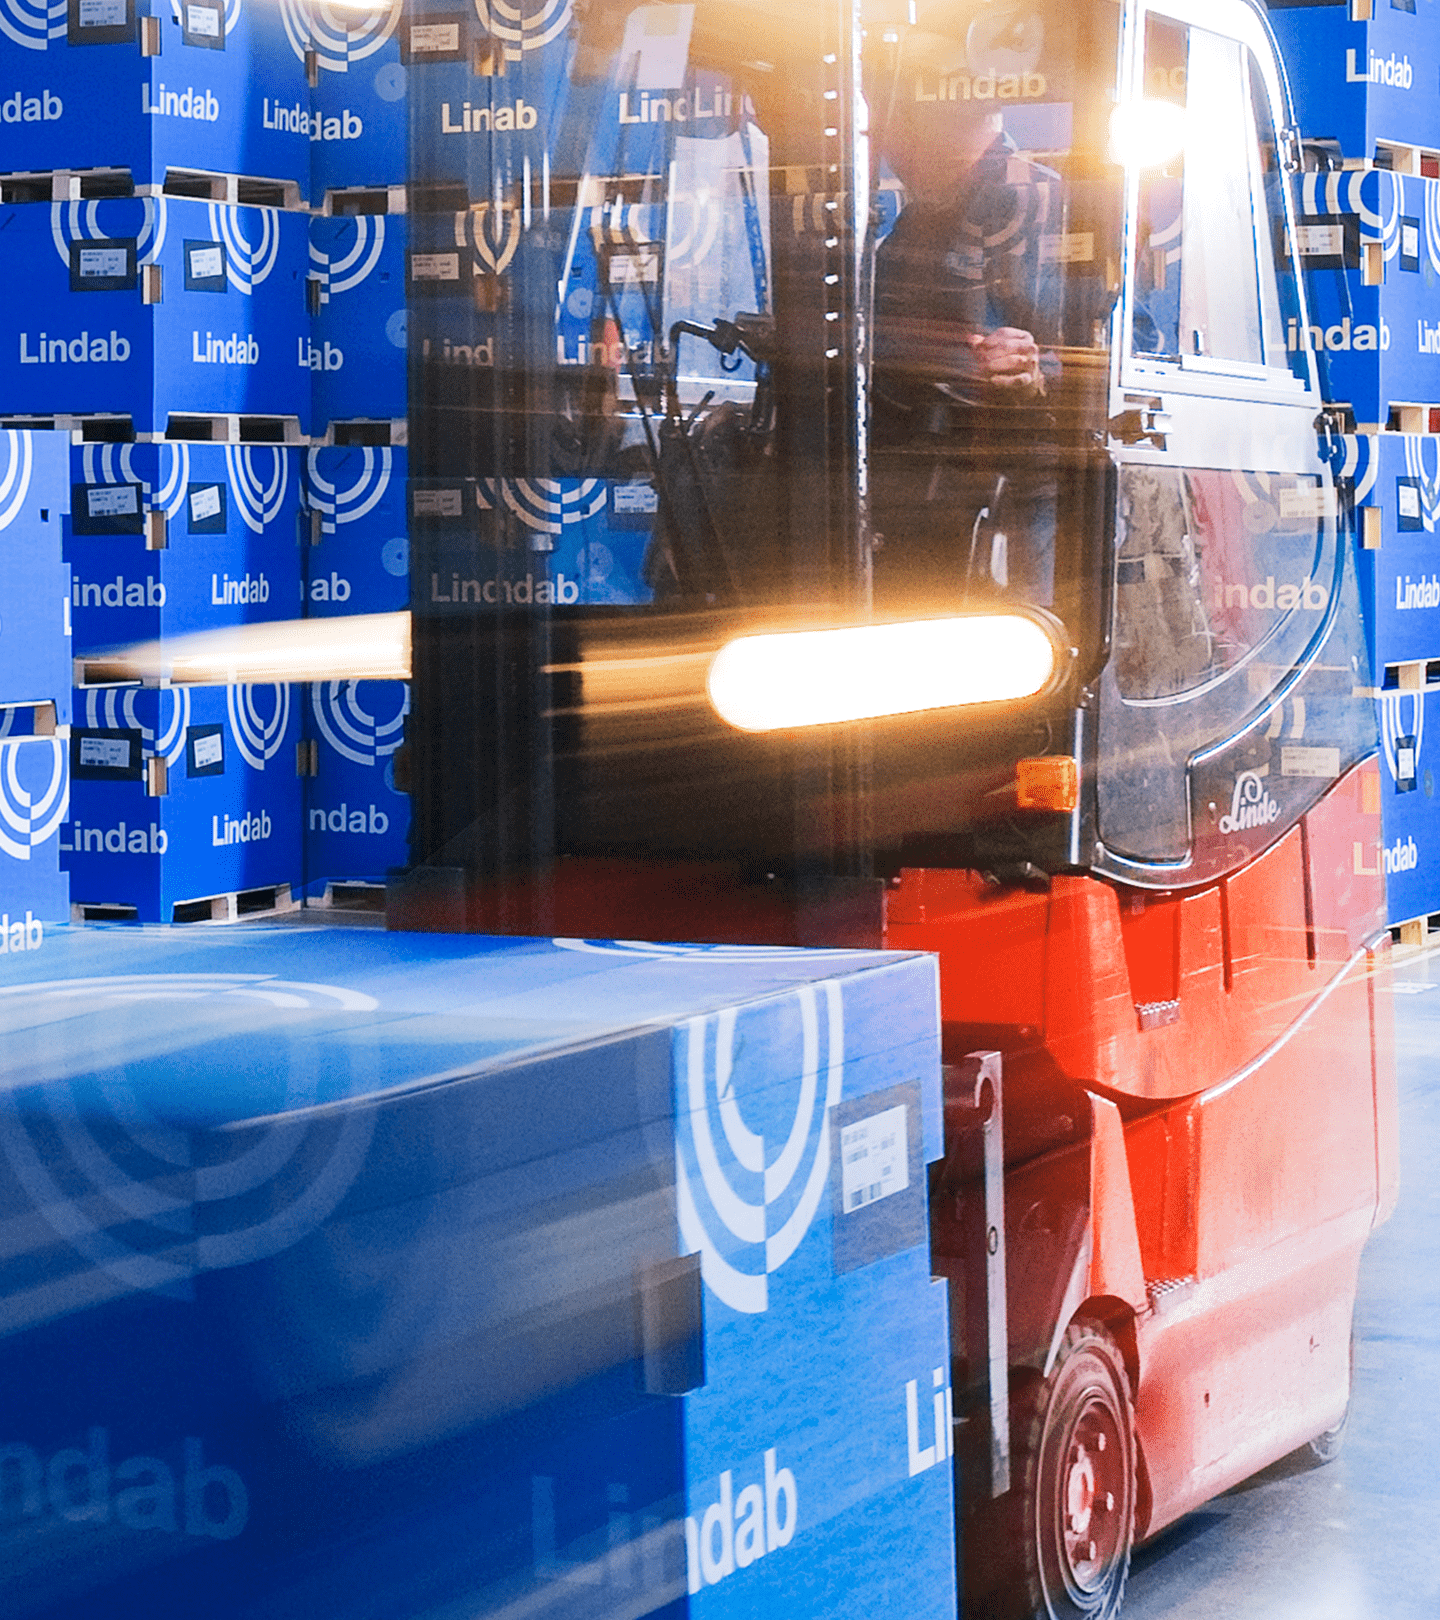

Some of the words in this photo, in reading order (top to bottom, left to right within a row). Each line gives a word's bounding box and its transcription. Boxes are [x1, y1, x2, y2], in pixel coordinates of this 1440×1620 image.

[916, 68, 1047, 102] Lindab
[1346, 48, 1413, 90] Lindab
[142, 82, 220, 122] Lindab
[19, 330, 131, 365] Lindab
[193, 331, 260, 367] Lindab
[1265, 316, 1391, 353] Lindab
[211, 573, 270, 605] Lindab
[1218, 771, 1281, 834] Linde
[211, 810, 272, 848] Lindab
[1353, 835, 1418, 876] Lindab
[530, 1447, 798, 1596] Lindab
